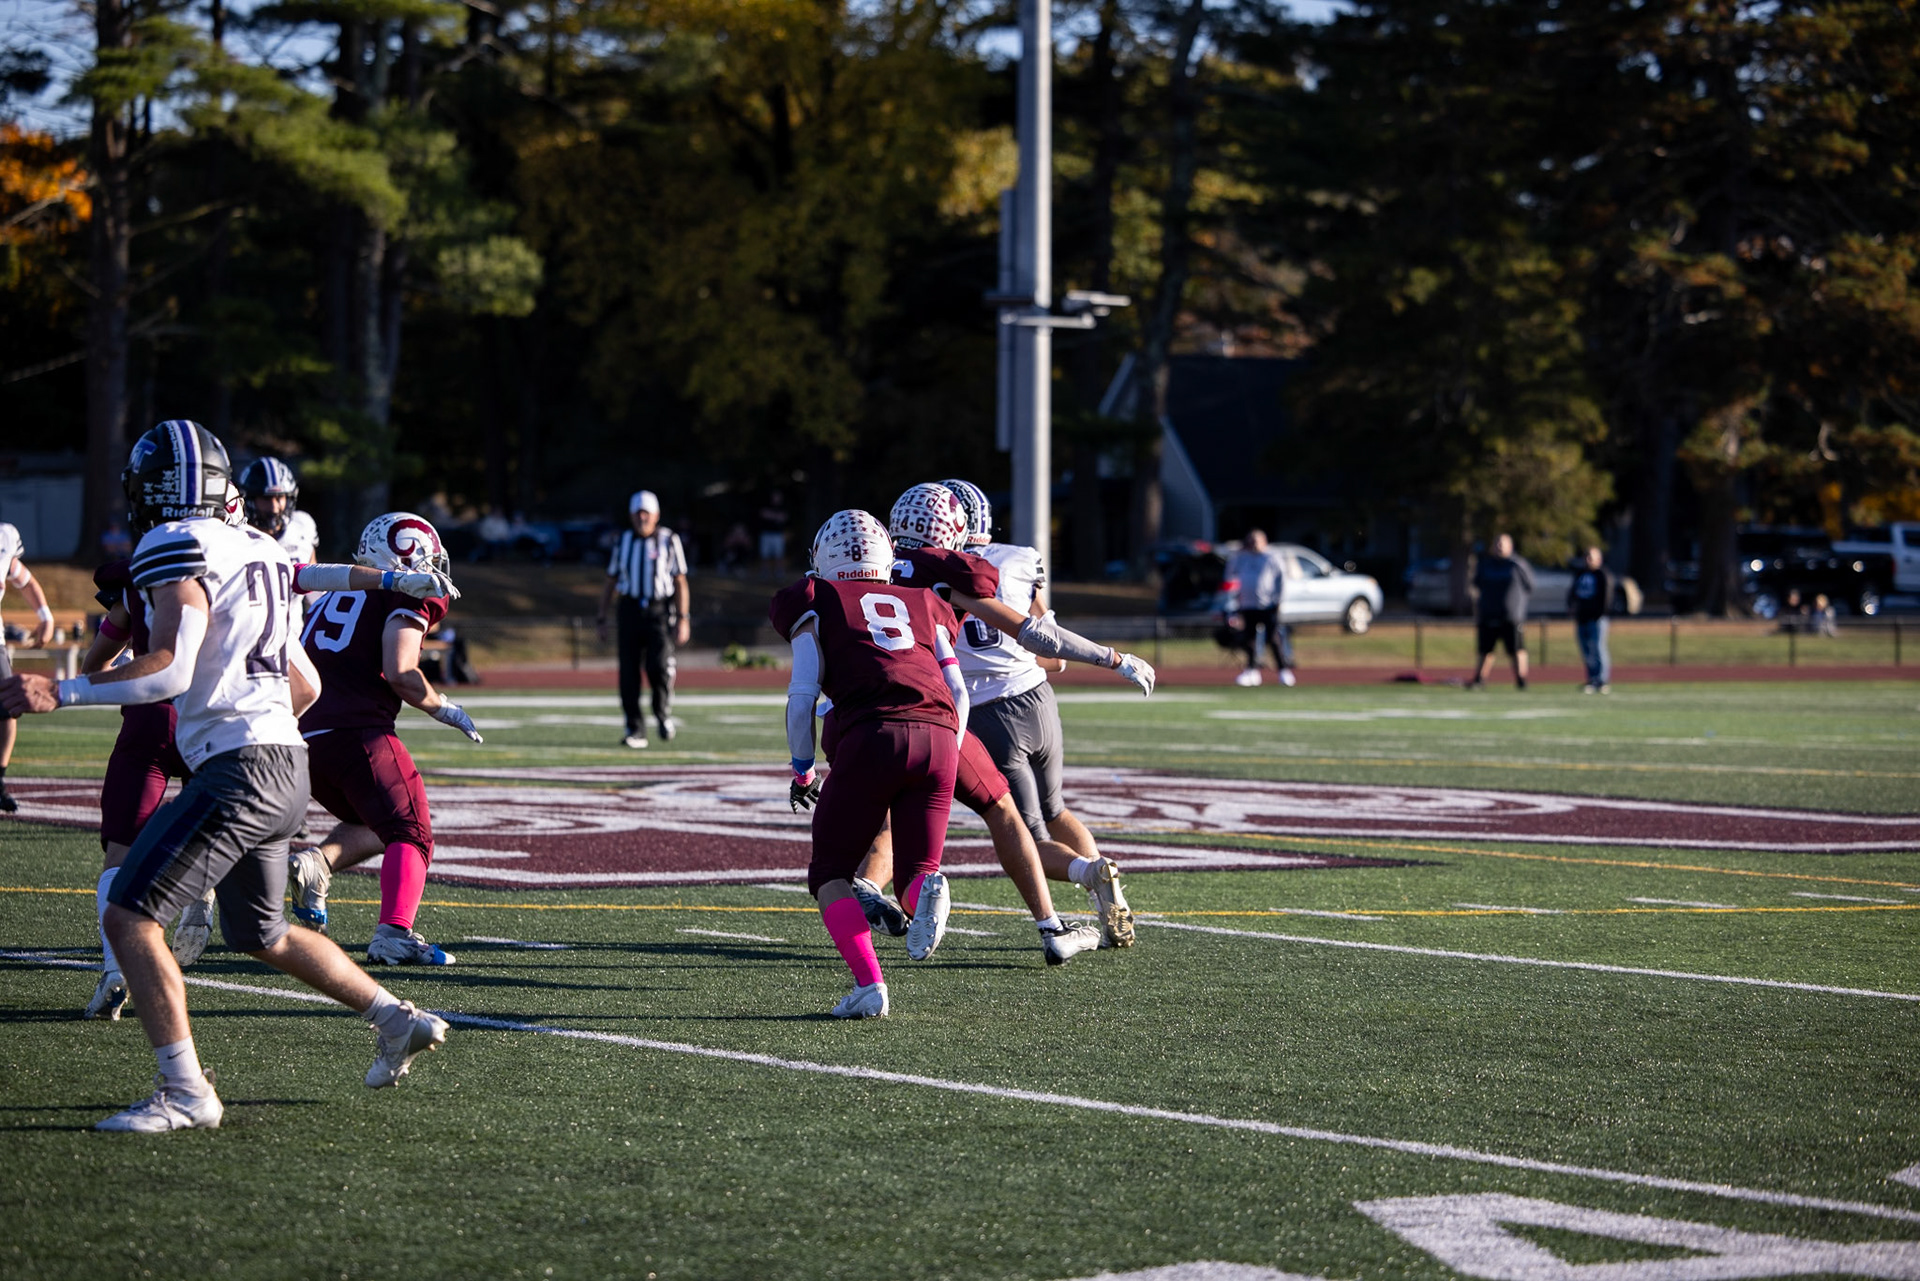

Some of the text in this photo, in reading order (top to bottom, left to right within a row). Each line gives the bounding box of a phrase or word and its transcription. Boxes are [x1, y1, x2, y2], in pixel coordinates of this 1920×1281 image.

[851, 544, 862, 562] 8
[837, 569, 878, 580] Riddell
[859, 592, 916, 652] 8
